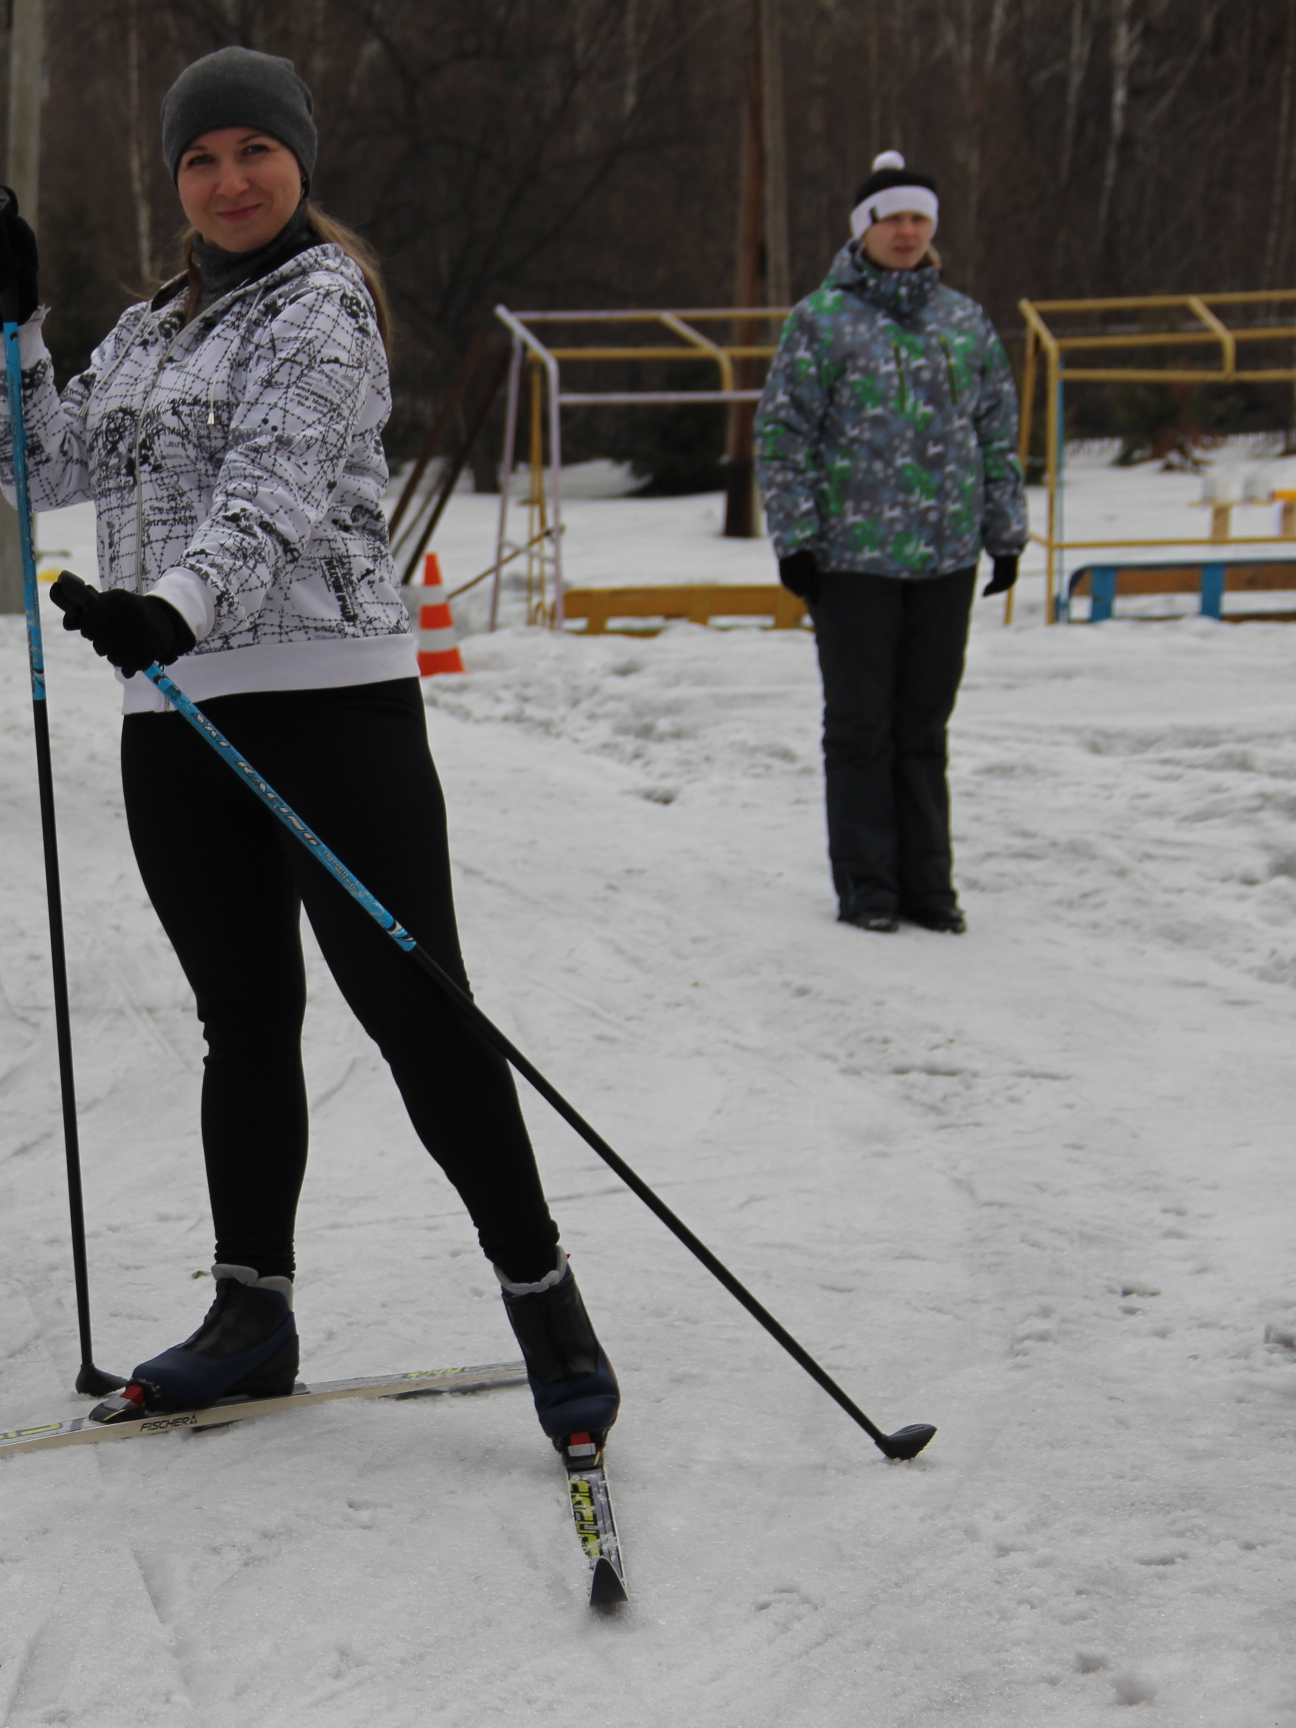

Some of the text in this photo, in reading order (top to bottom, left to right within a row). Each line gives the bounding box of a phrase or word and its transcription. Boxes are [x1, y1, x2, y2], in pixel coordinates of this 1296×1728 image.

[192, 713, 321, 846] SKI RACING
[334, 866, 358, 889] MATERIAL
[140, 1416, 190, 1432] FISCHER
